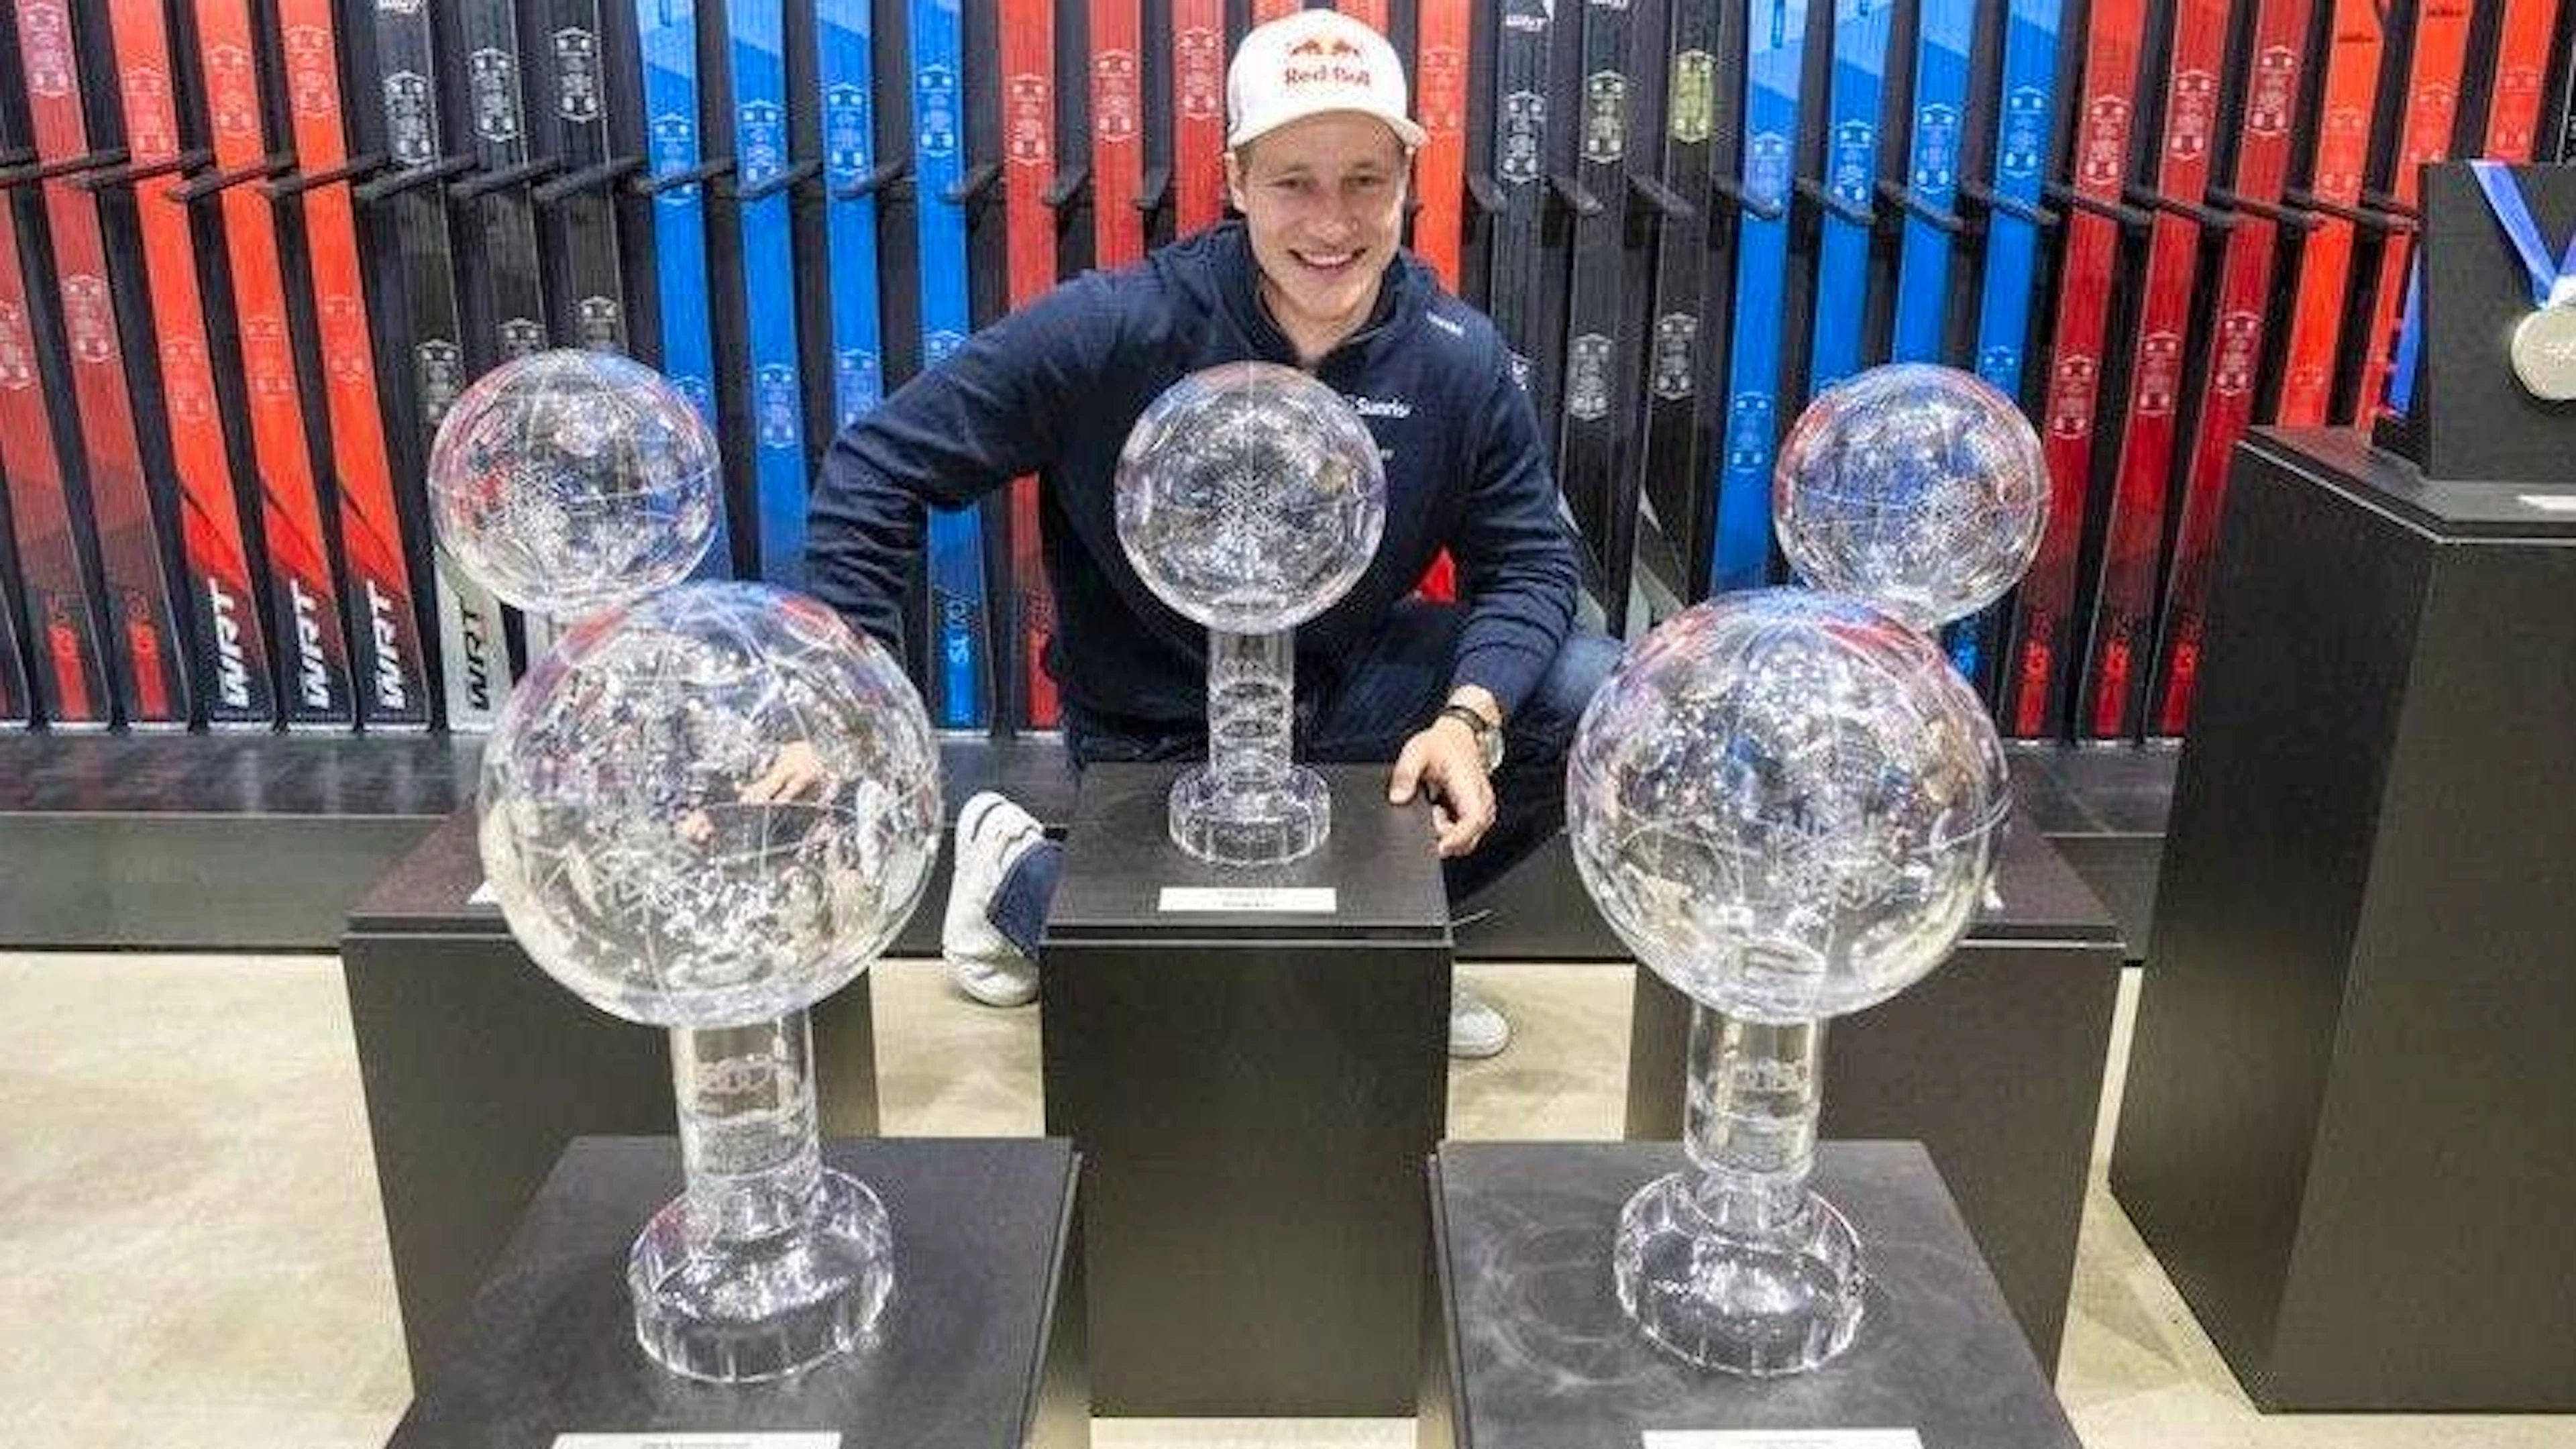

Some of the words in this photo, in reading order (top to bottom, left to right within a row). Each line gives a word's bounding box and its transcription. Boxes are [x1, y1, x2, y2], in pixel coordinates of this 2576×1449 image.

[1285, 66, 1327, 85] Red
[1334, 67, 1371, 86] Bull
[208, 577, 250, 708] WRT
[290, 578, 329, 708] WRT
[366, 578, 405, 709] WRT
[460, 597, 490, 710] WRT
